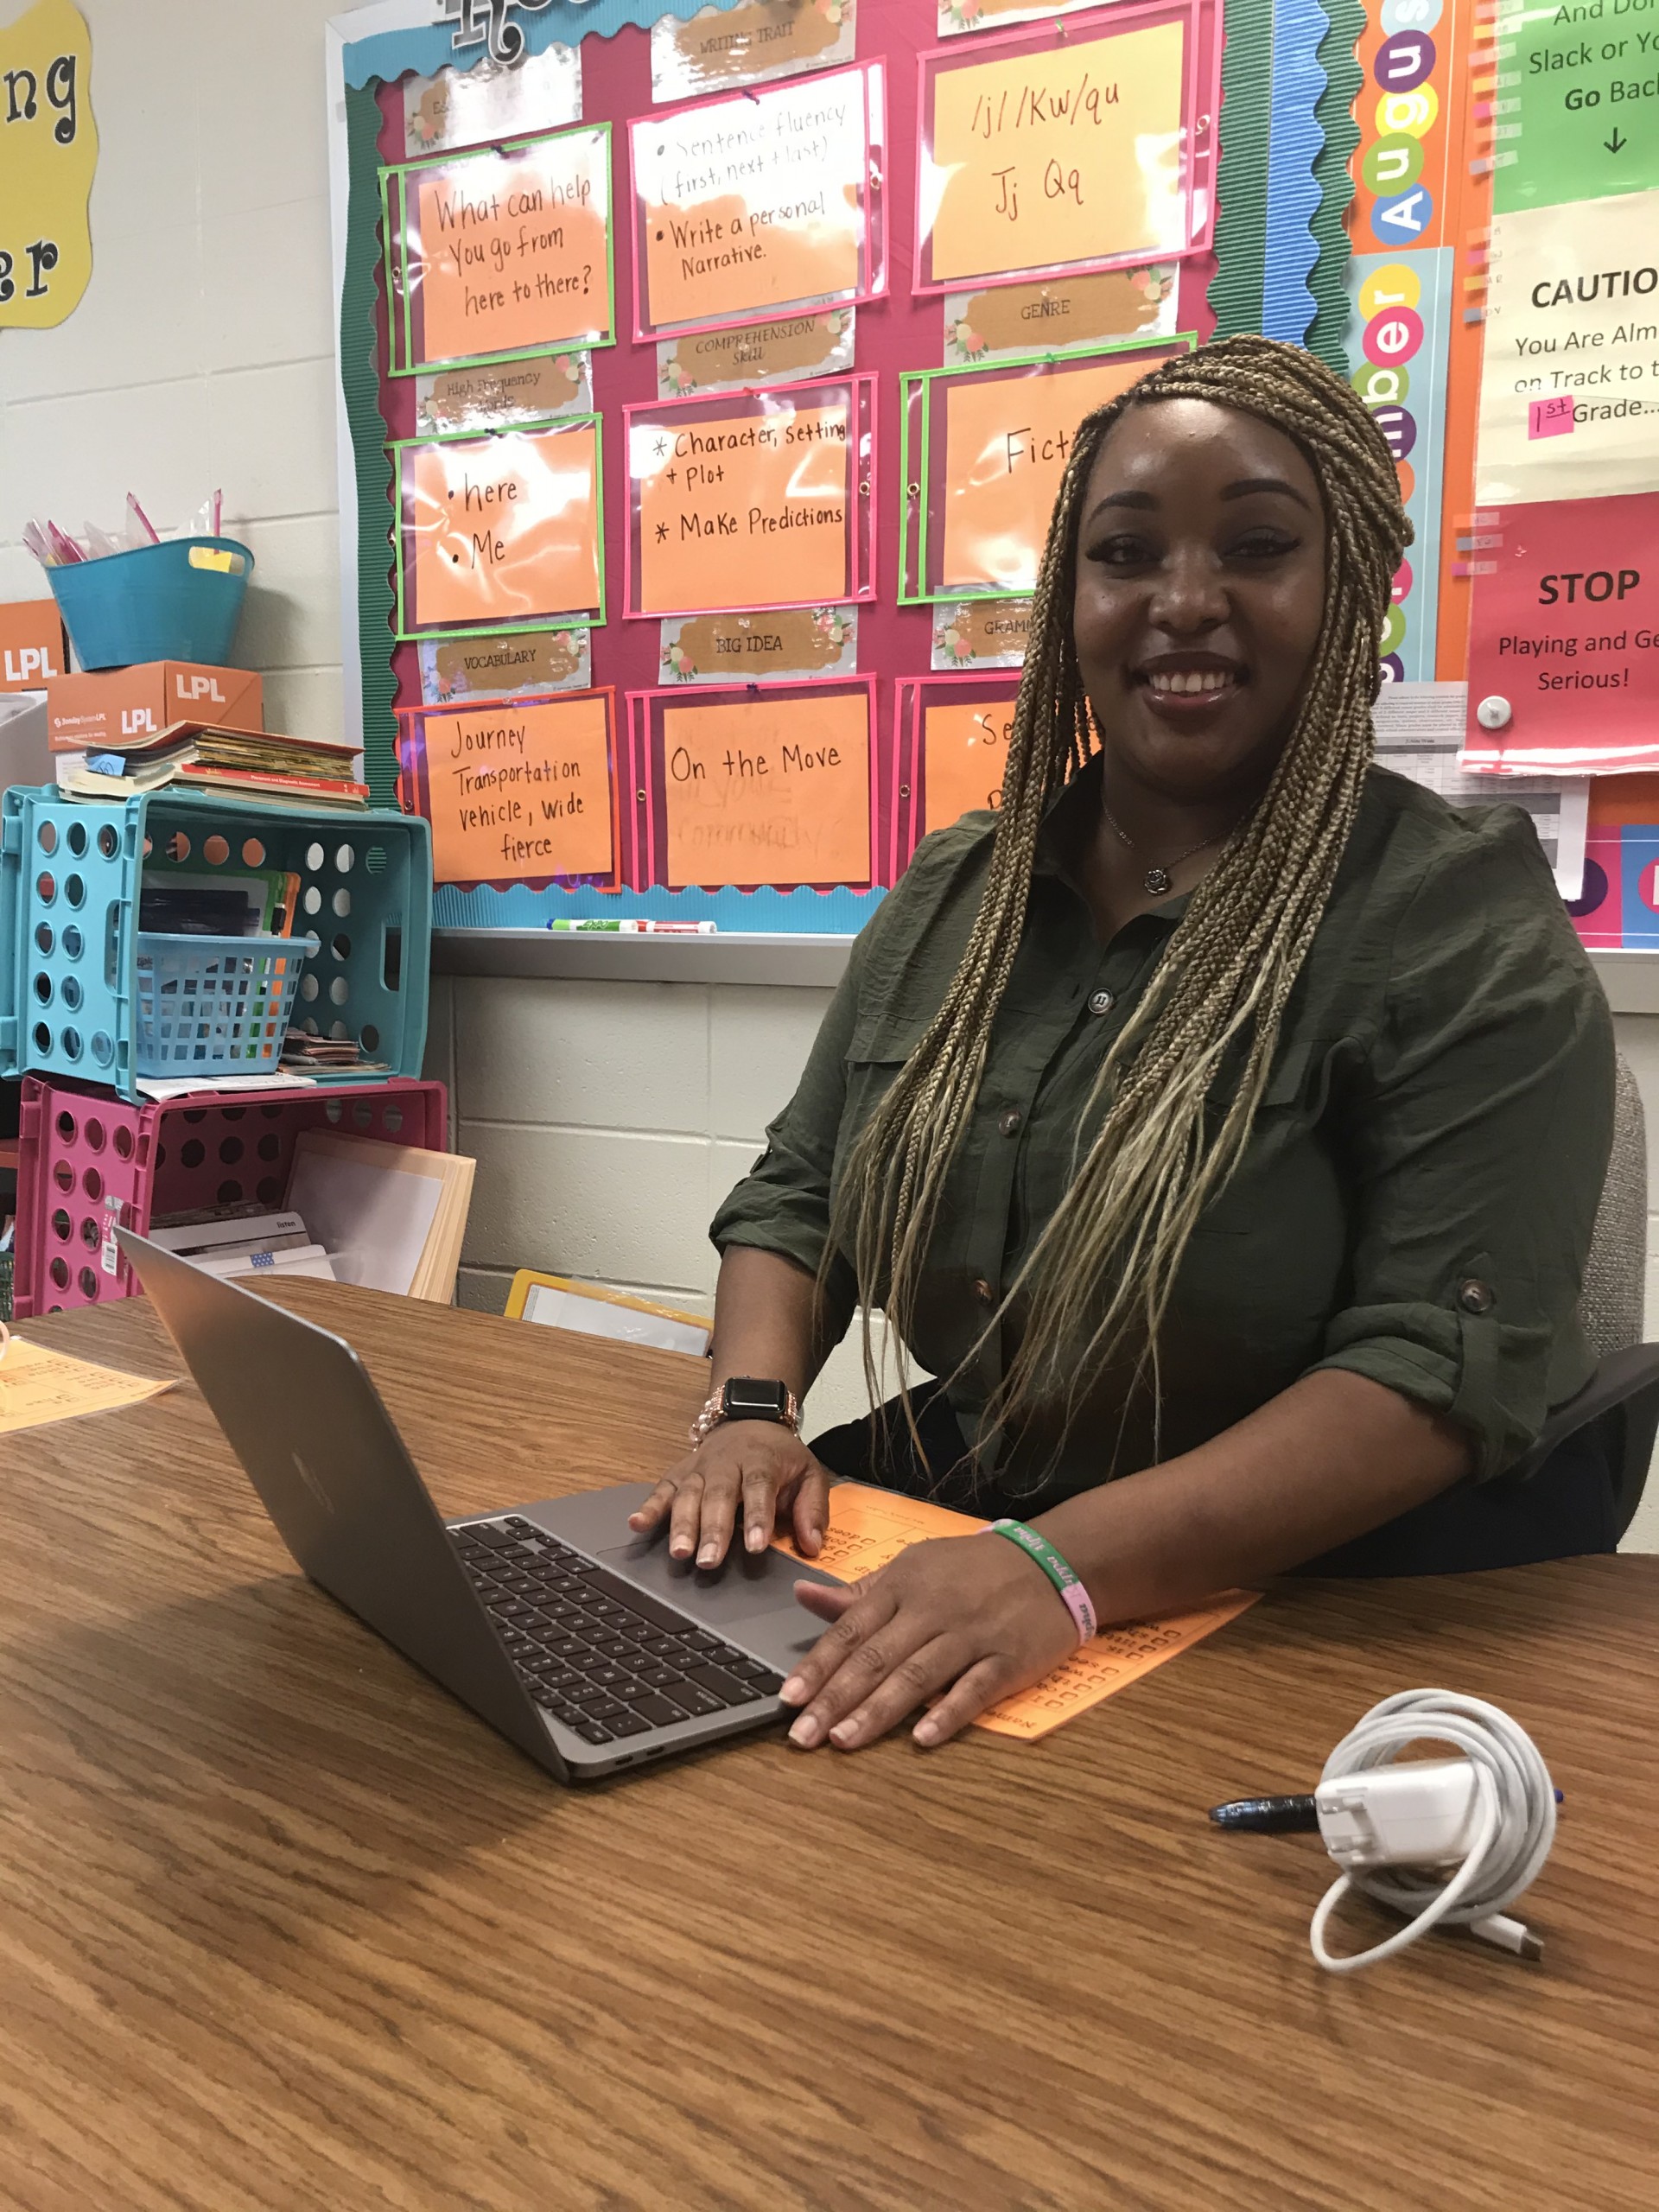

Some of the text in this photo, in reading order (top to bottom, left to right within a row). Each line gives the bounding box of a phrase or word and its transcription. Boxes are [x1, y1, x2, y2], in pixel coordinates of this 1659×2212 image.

[1554, 0, 1603, 26] And
[700, 21, 795, 54] WRITING TRAIT
[1529, 42, 1592, 73] Slack
[1601, 41, 1629, 60] or
[1565, 73, 1659, 111] Go Bac
[776, 104, 846, 134] fluency
[727, 156, 765, 181] next
[435, 175, 591, 232] What can help
[670, 192, 825, 250] Write a personal
[449, 226, 564, 276] You go from
[682, 244, 767, 280] Narrative.
[465, 265, 592, 316] here to there?
[1021, 300, 1071, 321] GENRE
[696, 320, 815, 354] COMPREHENSION
[1516, 337, 1557, 356] You
[1564, 332, 1604, 351] Are
[732, 346, 764, 365] Skill
[448, 379, 474, 397] High
[1515, 377, 1542, 393] on
[1550, 365, 1611, 389] Track
[1619, 365, 1643, 381] to
[674, 427, 778, 457] Character,
[1007, 428, 1077, 474] Fict
[465, 473, 518, 512] here
[748, 506, 843, 535] Predictions
[472, 530, 505, 569] Me
[1538, 569, 1641, 605] STOP
[716, 635, 783, 654] BIG IDEA
[1499, 635, 1578, 658] Playing
[1585, 630, 1627, 652] and
[4, 647, 57, 682] LPL
[464, 650, 537, 671] VOCABULARY
[175, 674, 226, 702] LPL
[1538, 668, 1629, 690] Serious!
[121, 709, 156, 734] LPL
[451, 721, 525, 760] Journey
[453, 760, 581, 796] Transportation
[671, 744, 841, 782] On the Move
[501, 834, 552, 861] fierce
[276, 1220, 296, 1230] listen
